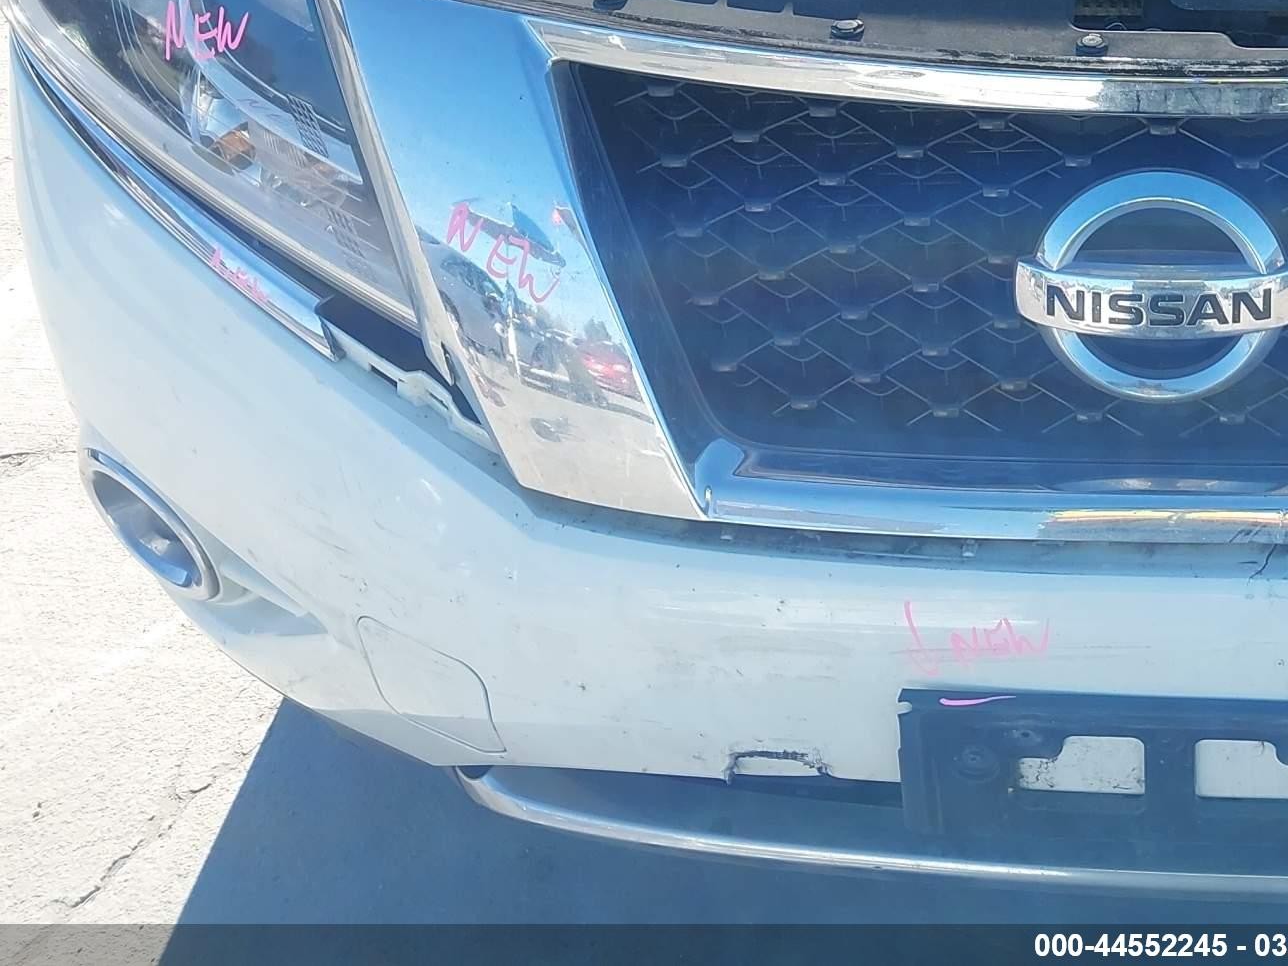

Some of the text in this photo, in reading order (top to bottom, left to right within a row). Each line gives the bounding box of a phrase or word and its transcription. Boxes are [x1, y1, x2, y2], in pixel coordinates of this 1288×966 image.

[165, 0, 249, 62] NEW
[446, 201, 560, 304] NEW
[1046, 285, 1272, 326] NISSAN
